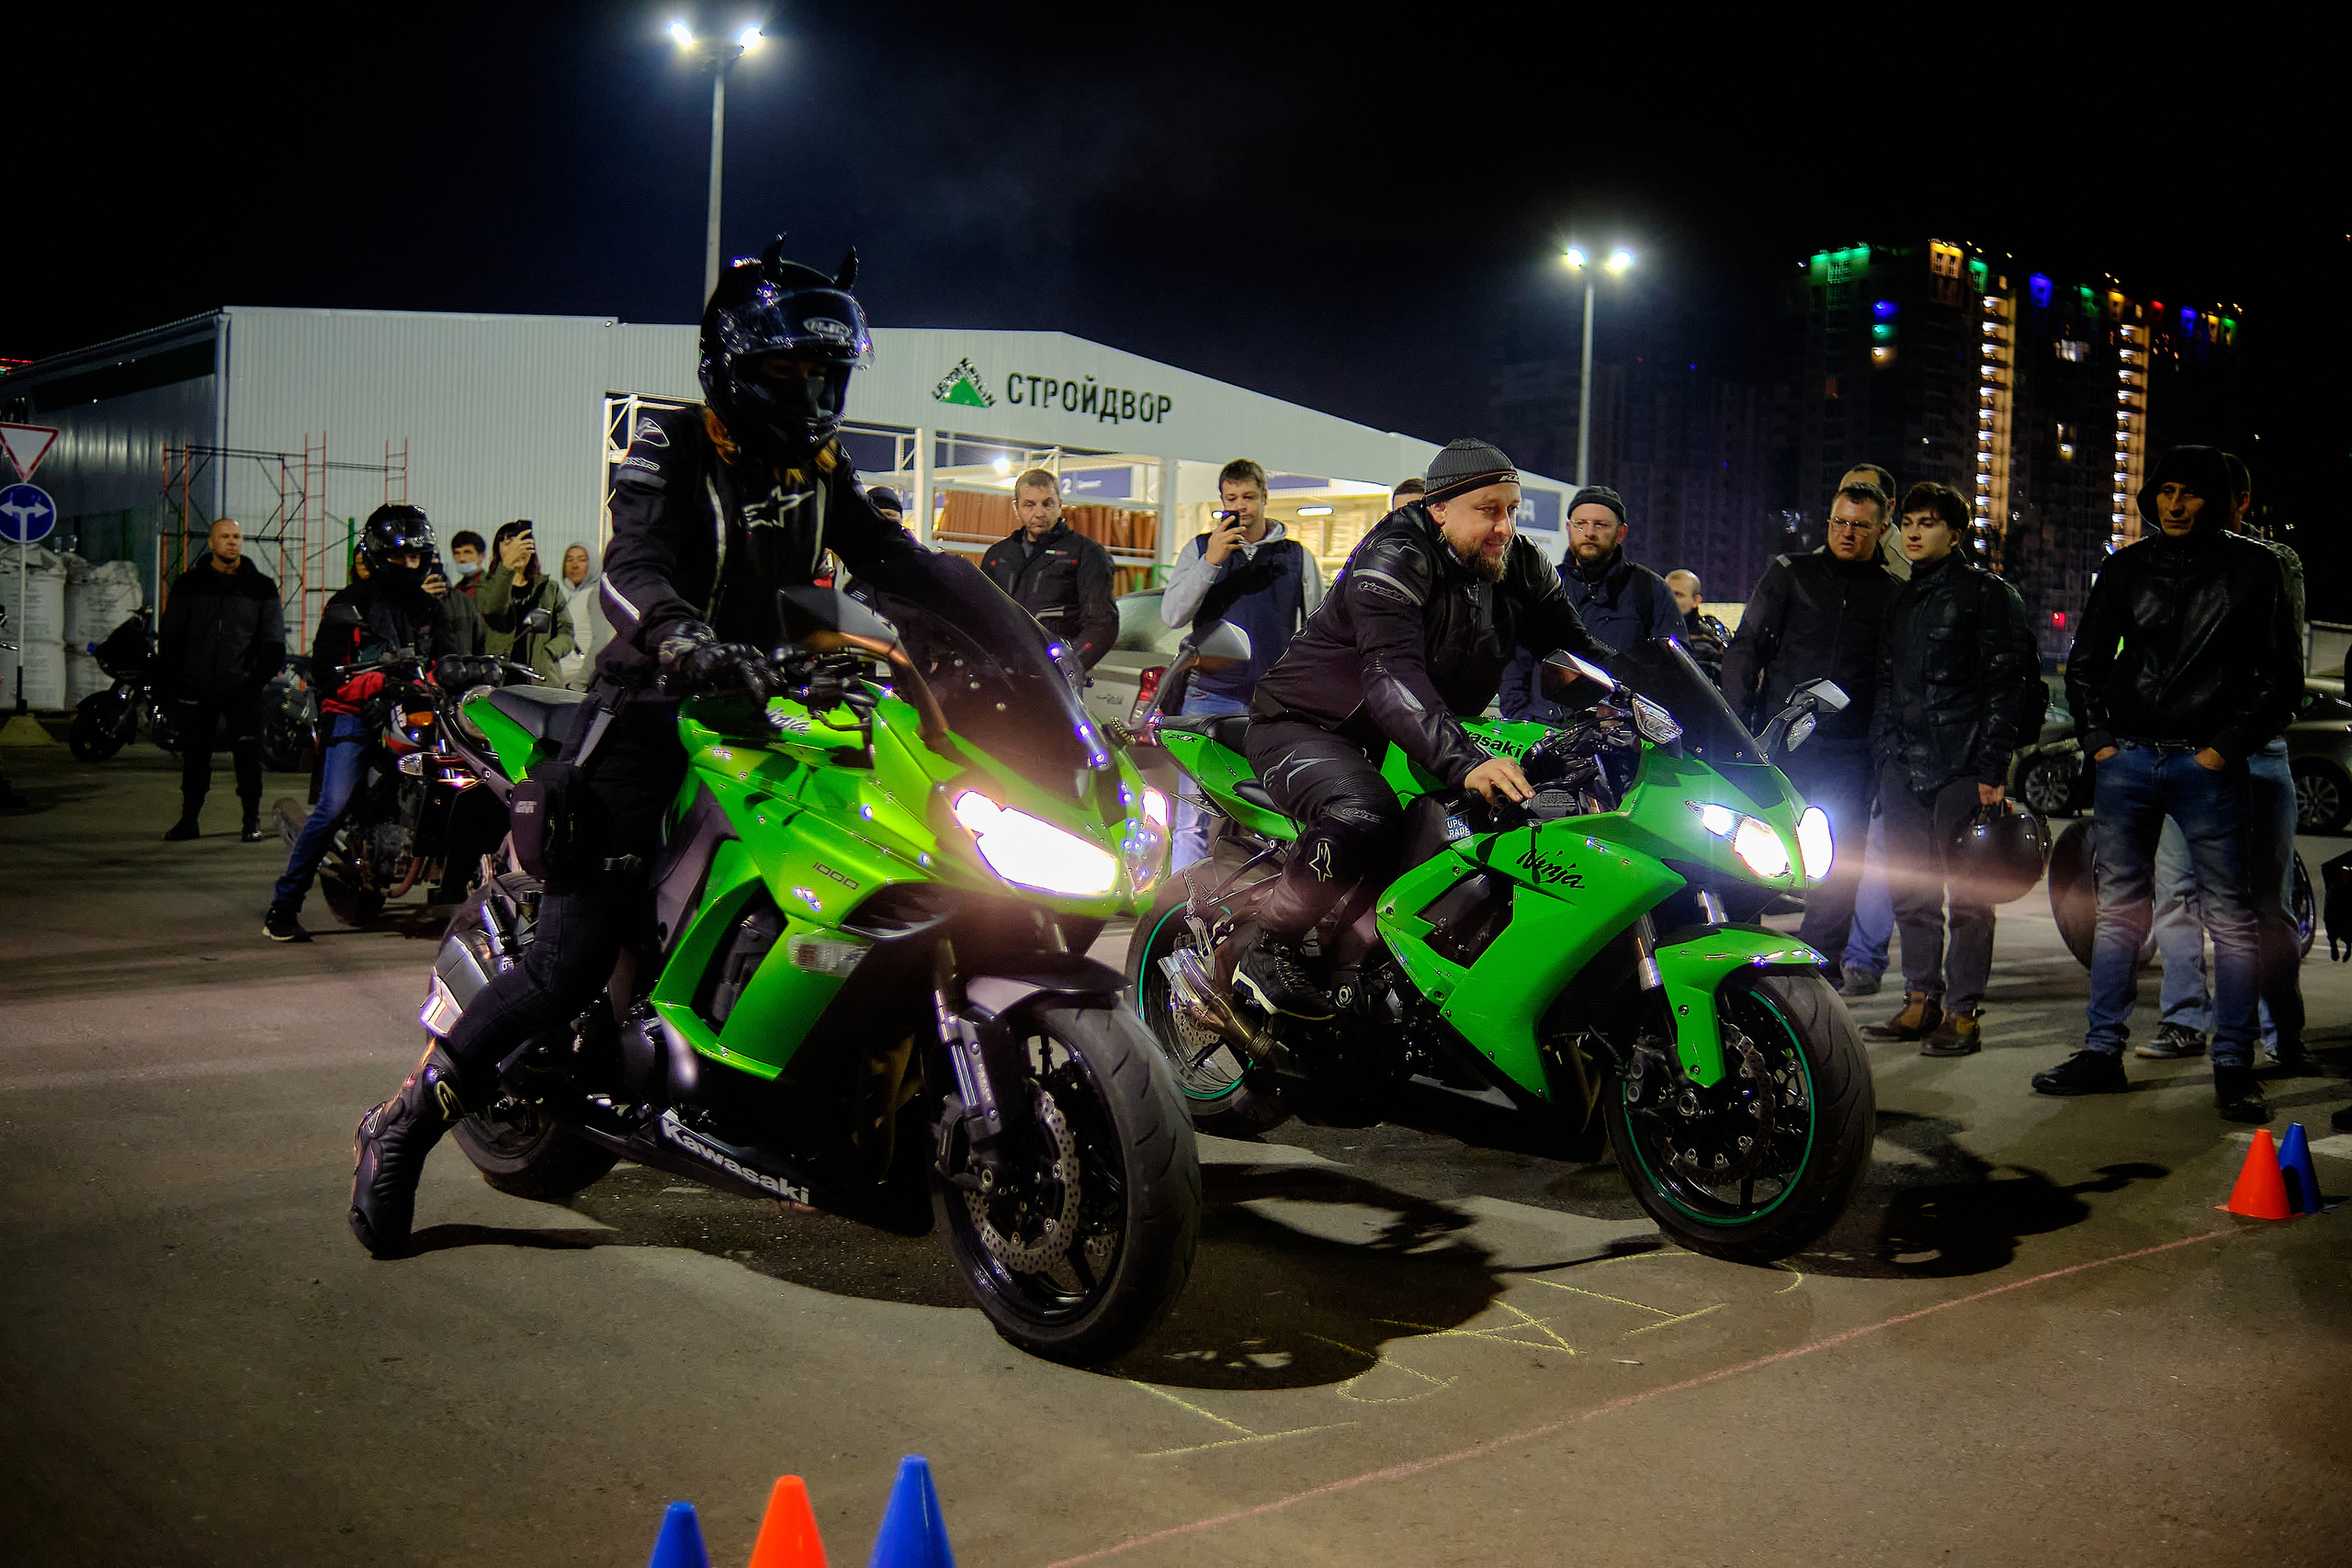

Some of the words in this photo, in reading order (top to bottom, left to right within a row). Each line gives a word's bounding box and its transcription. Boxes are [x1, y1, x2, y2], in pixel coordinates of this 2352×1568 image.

[1007, 372, 1171, 424] СТРОЙДВОР
[812, 861, 860, 890] 1000
[1516, 848, 1586, 889] Ninja
[661, 1116, 810, 1205] Kawasaki
